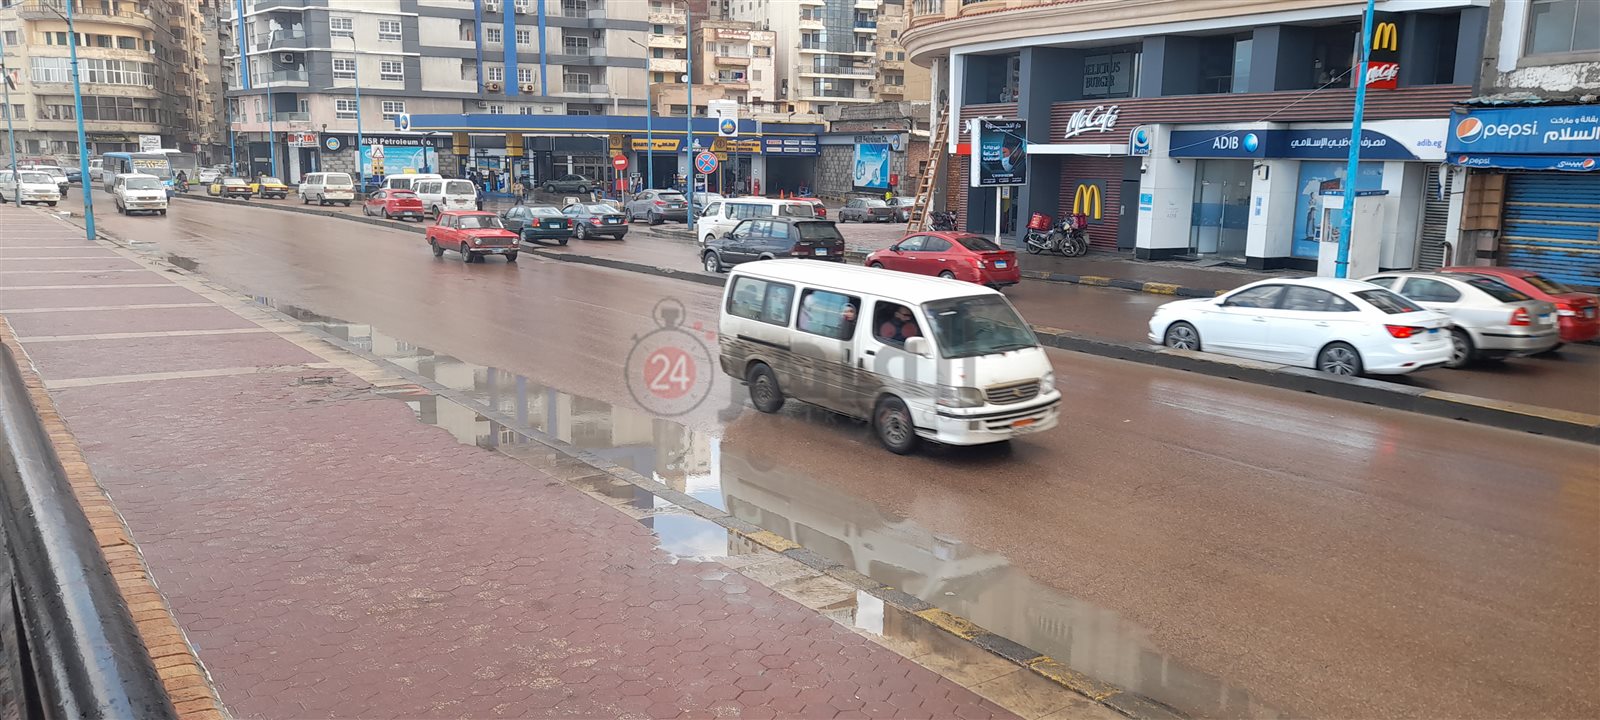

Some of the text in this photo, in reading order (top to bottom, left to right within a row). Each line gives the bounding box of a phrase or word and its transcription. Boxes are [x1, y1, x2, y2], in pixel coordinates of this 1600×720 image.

[1086, 75, 1115, 88] BURGER
[1064, 105, 1121, 138] McCafé
[1580, 115, 1599, 123] بقالة
[1483, 120, 1537, 139] pepsi
[1543, 126, 1600, 144] السلام
[380, 138, 418, 146] Petroleum
[1212, 136, 1239, 150] ADIB
[1290, 137, 1328, 149] الإسلامي
[1417, 139, 1443, 149] adib.eg
